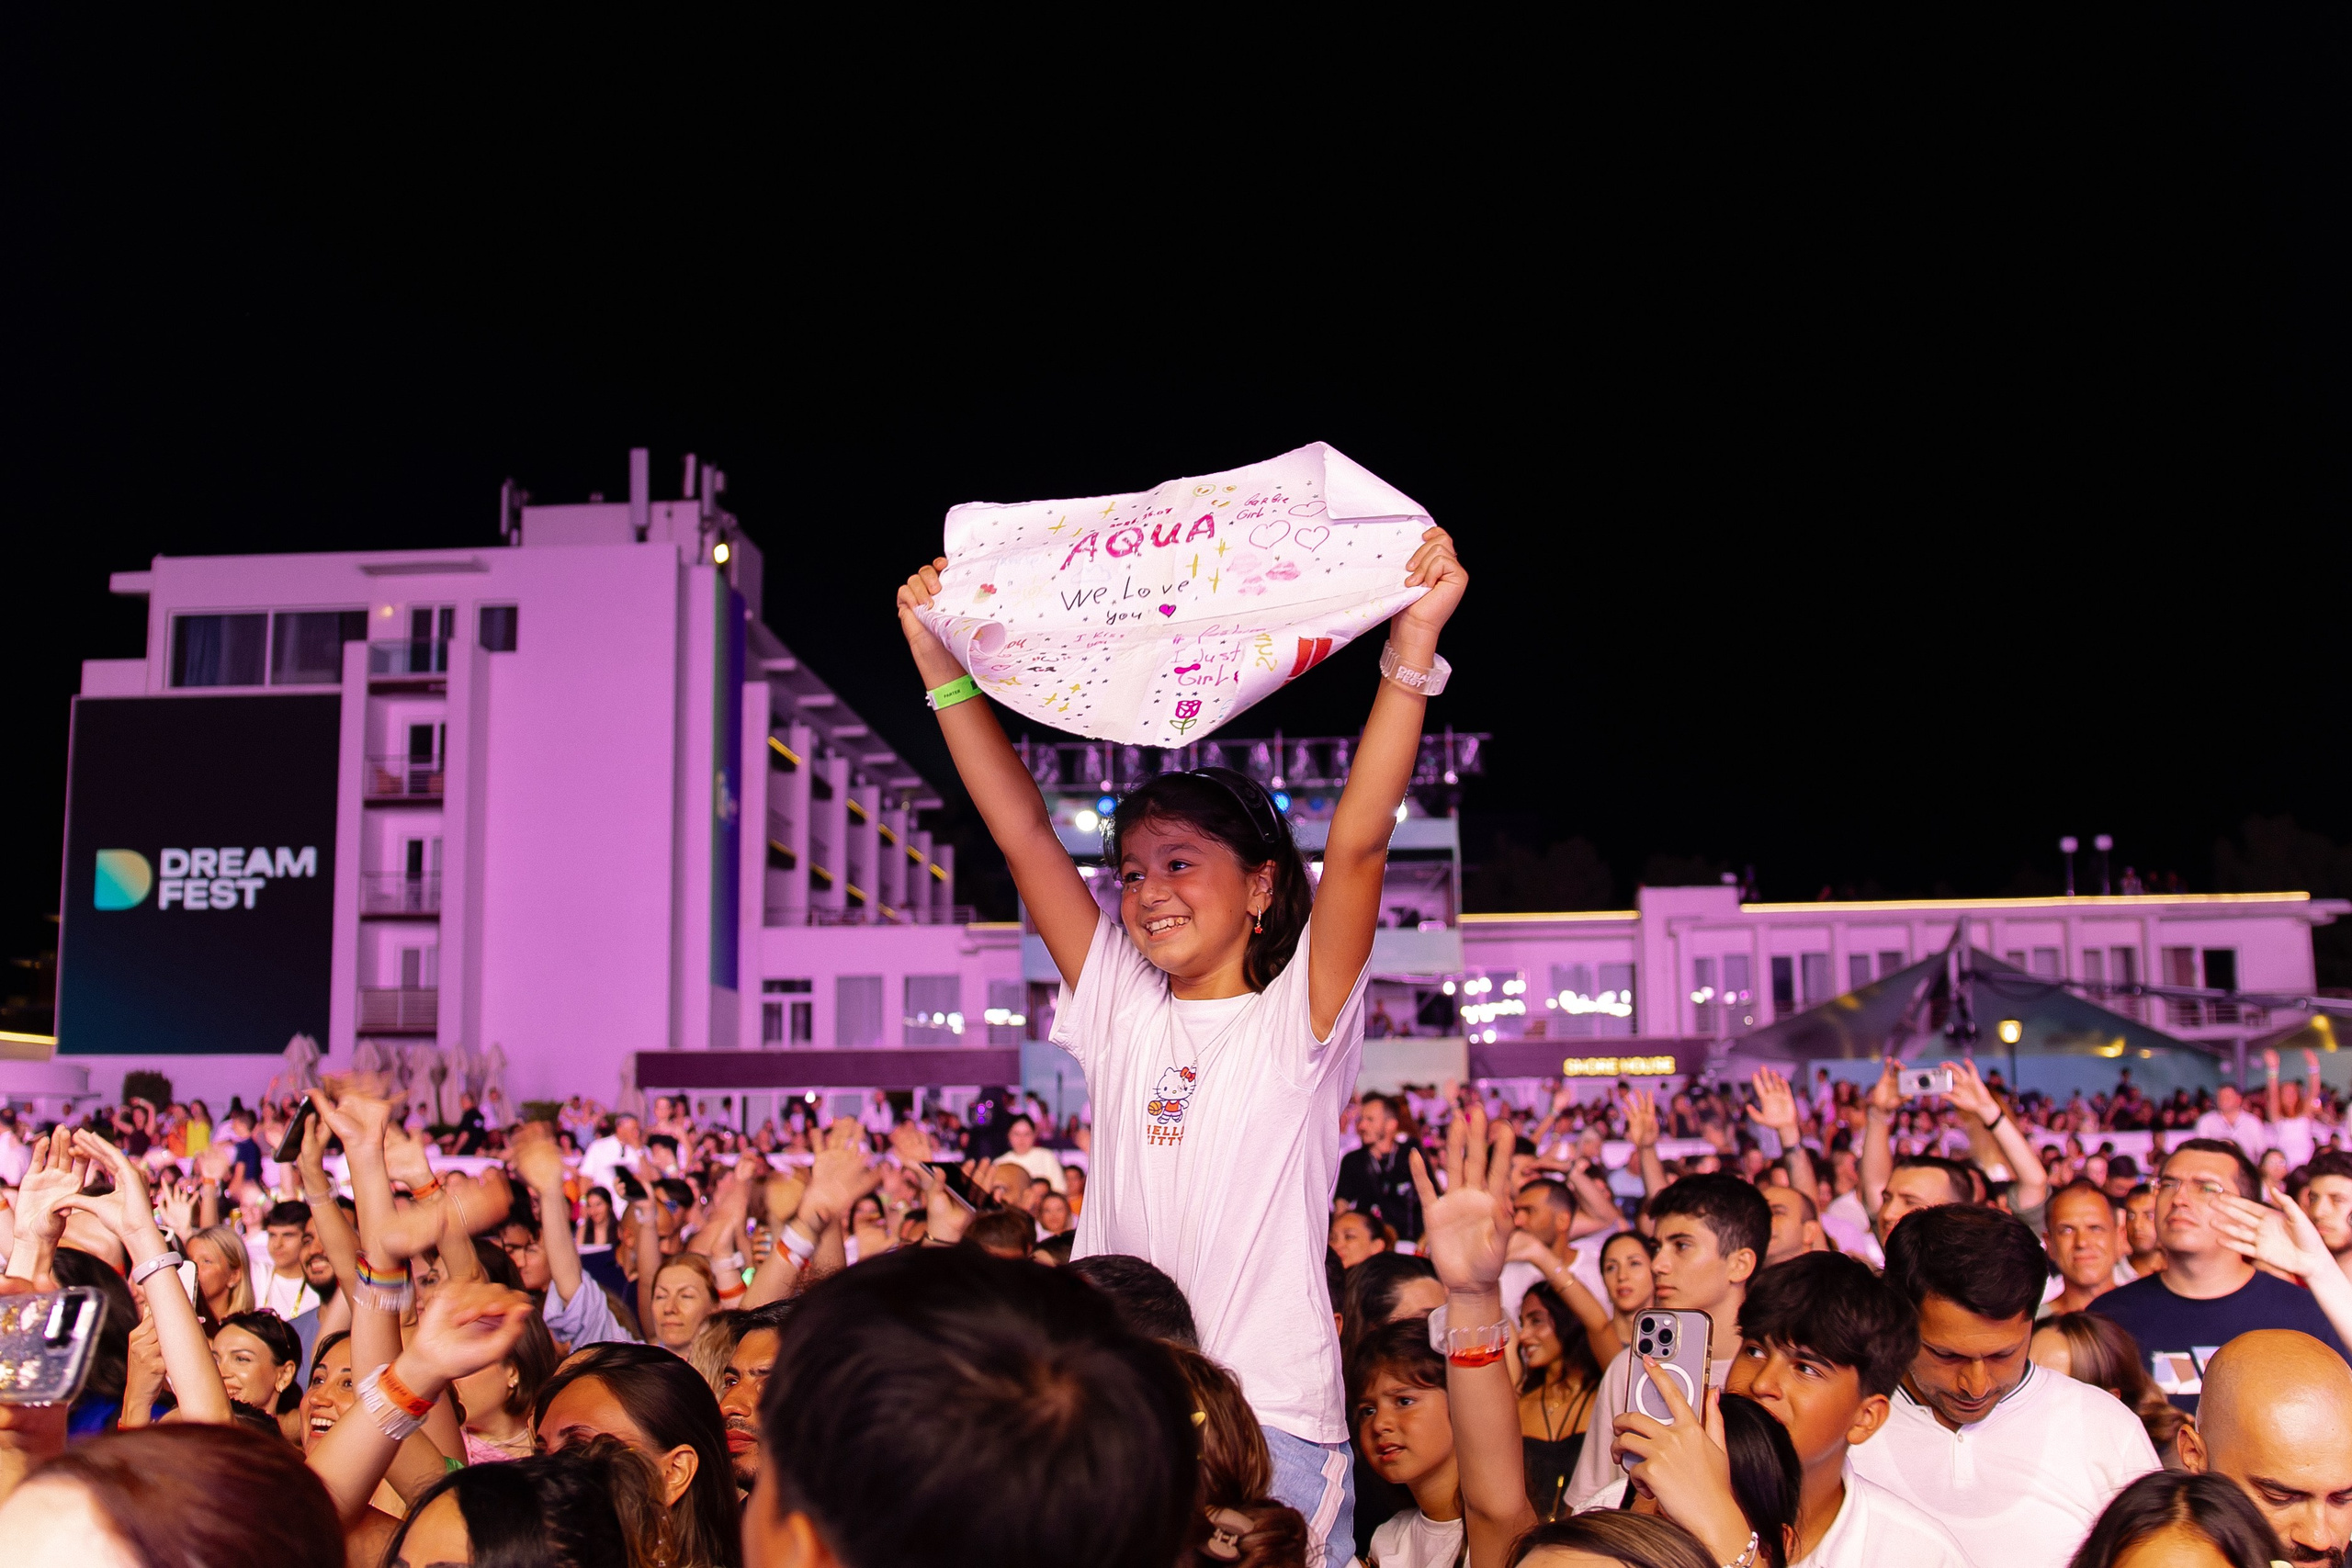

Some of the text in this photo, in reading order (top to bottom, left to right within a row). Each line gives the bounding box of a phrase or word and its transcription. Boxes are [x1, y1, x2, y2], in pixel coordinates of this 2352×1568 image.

[1059, 513, 1215, 570] AQUA
[1060, 576, 1190, 611] We Love
[1105, 610, 1143, 626] you
[160, 847, 317, 878] DREAM
[158, 878, 266, 910] FEST
[1148, 1135, 1183, 1146] ITTY
